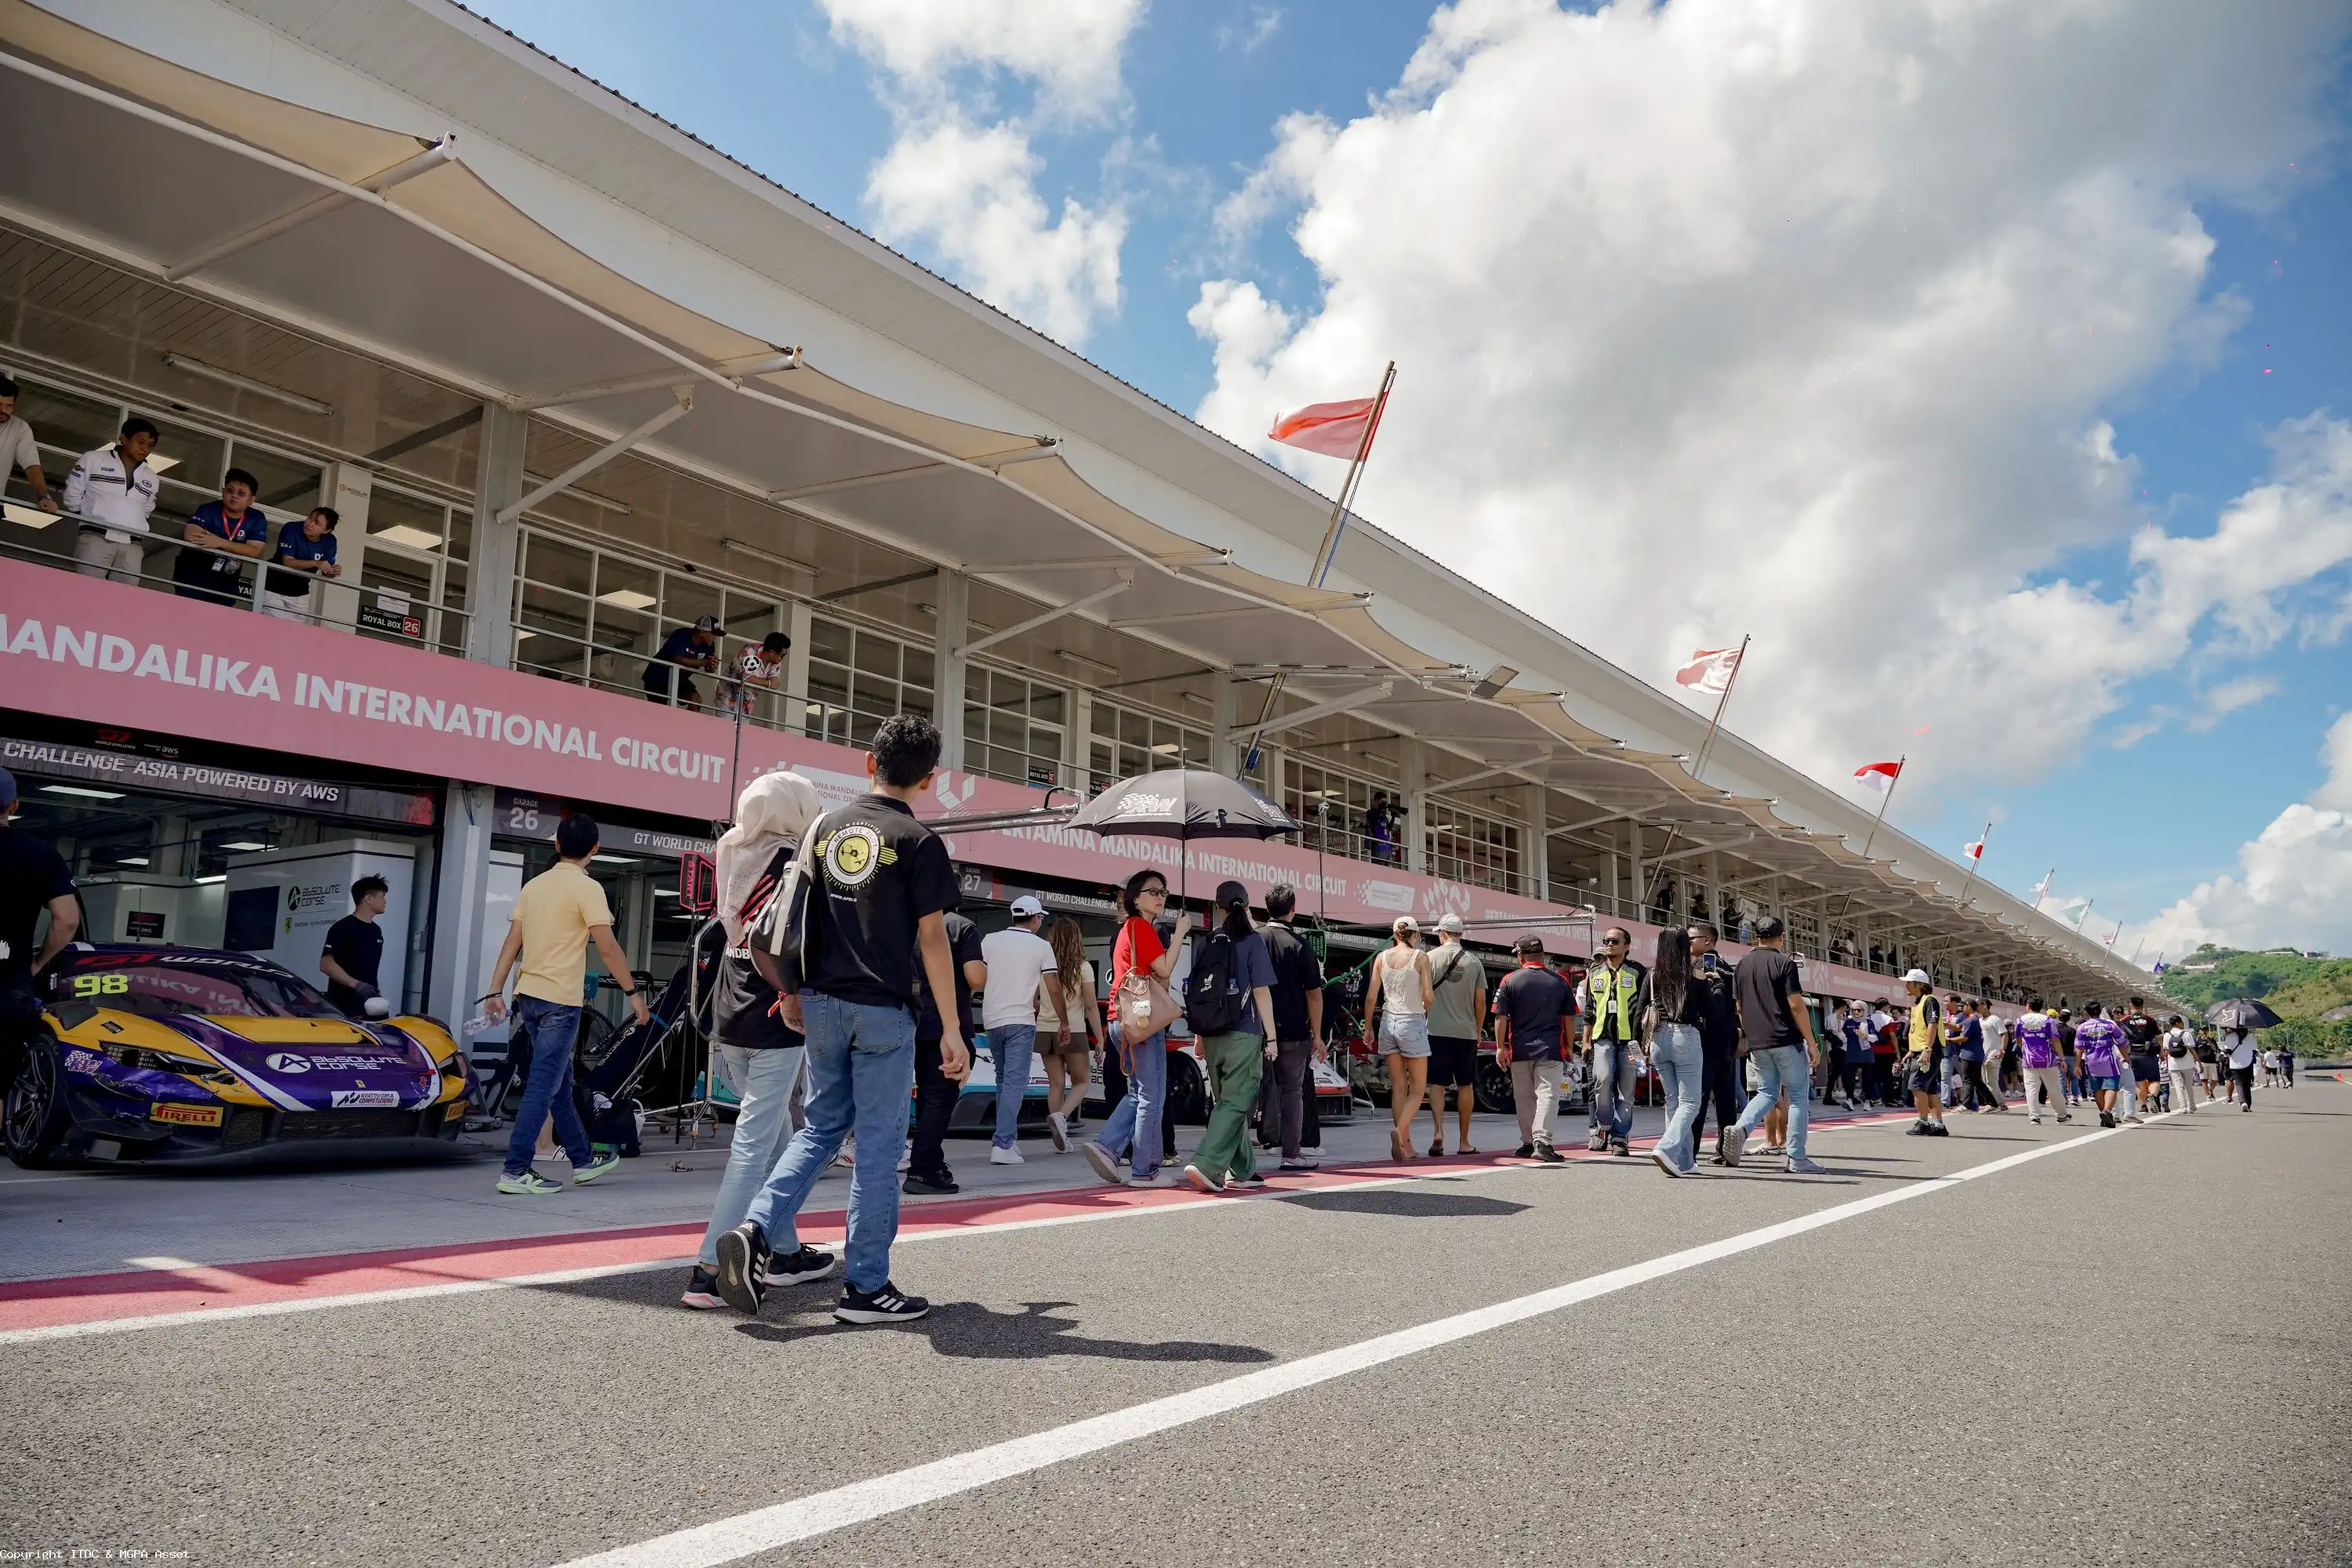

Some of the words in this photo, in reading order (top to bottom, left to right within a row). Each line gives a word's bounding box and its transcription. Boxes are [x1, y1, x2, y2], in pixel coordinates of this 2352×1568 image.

[363, 614, 386, 626] ROYAL
[387, 620, 401, 630] BOX
[404, 621, 419, 633] 26
[0, 613, 281, 702] ANDALIKA
[294, 672, 602, 760] INTERNATIONAL
[612, 736, 725, 783] CIRCUIT
[162, 746, 179, 755] aws
[3, 742, 126, 772] CHALLENGE
[132, 760, 178, 780] ASIA
[183, 767, 271, 792] POWERED
[274, 780, 299, 796] BY
[300, 784, 339, 801] AWS
[830, 784, 867, 797] MANDALI
[514, 797, 539, 808] GARAGE
[510, 807, 539, 831] 26
[633, 832, 650, 845] GT
[652, 834, 692, 851] WORLD
[834, 827, 862, 843] REMOTE
[866, 831, 878, 848] PILOT
[1100, 835, 1196, 869] MANDALIKA
[1199, 851, 1301, 889] INTERNATIONAL
[1305, 873, 1347, 896] CIRCUIT
[964, 873, 982, 891] 27
[1036, 891, 1045, 899] GT
[1046, 891, 1070, 903] WORLD
[1071, 895, 1109, 908] CHALLENGE
[74, 975, 128, 996] 98
[1594, 979, 1603, 989] RR
[155, 1104, 217, 1122] PIRELLI
